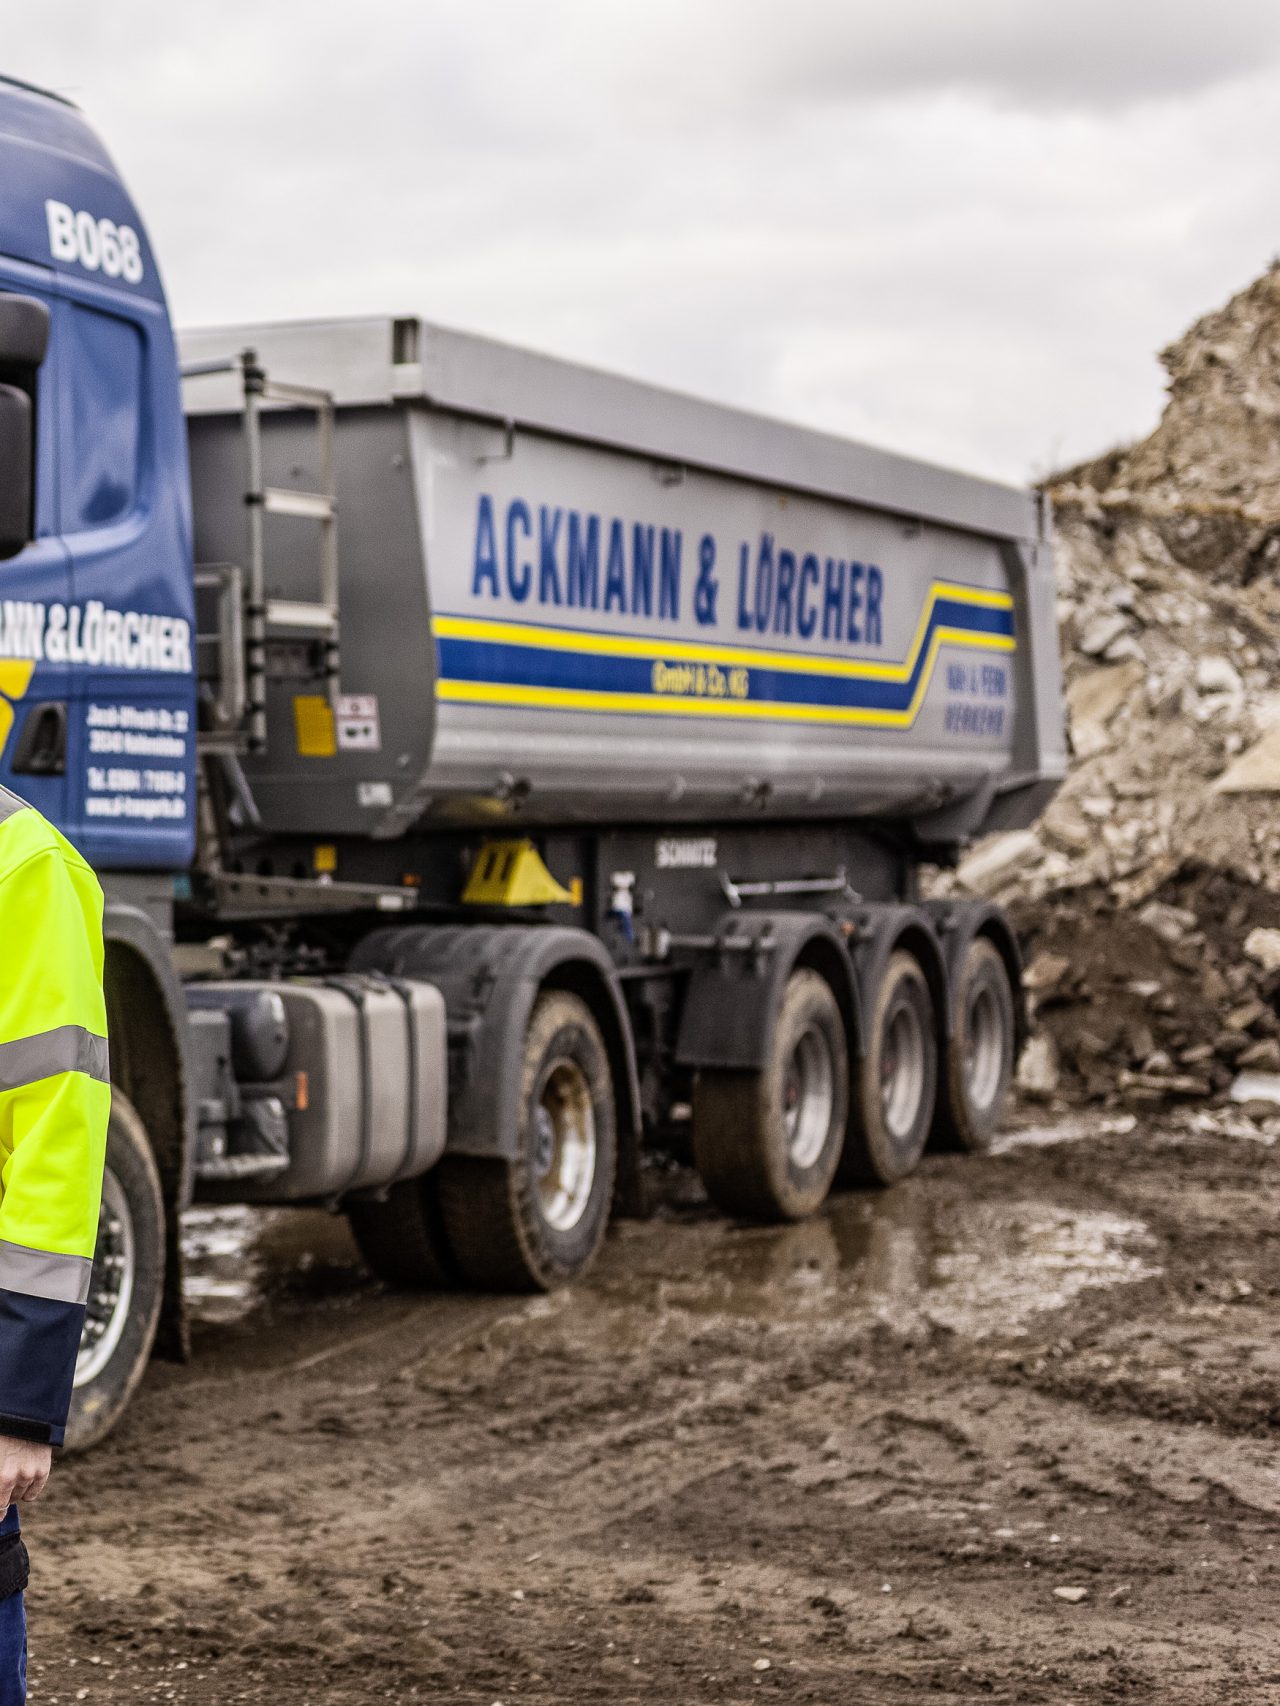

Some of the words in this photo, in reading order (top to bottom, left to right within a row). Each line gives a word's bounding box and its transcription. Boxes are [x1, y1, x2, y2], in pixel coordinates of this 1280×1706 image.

[45, 198, 144, 284] B068
[471, 493, 683, 621] ACKMANN
[694, 532, 718, 626] &
[737, 531, 883, 647] LÖRCHER
